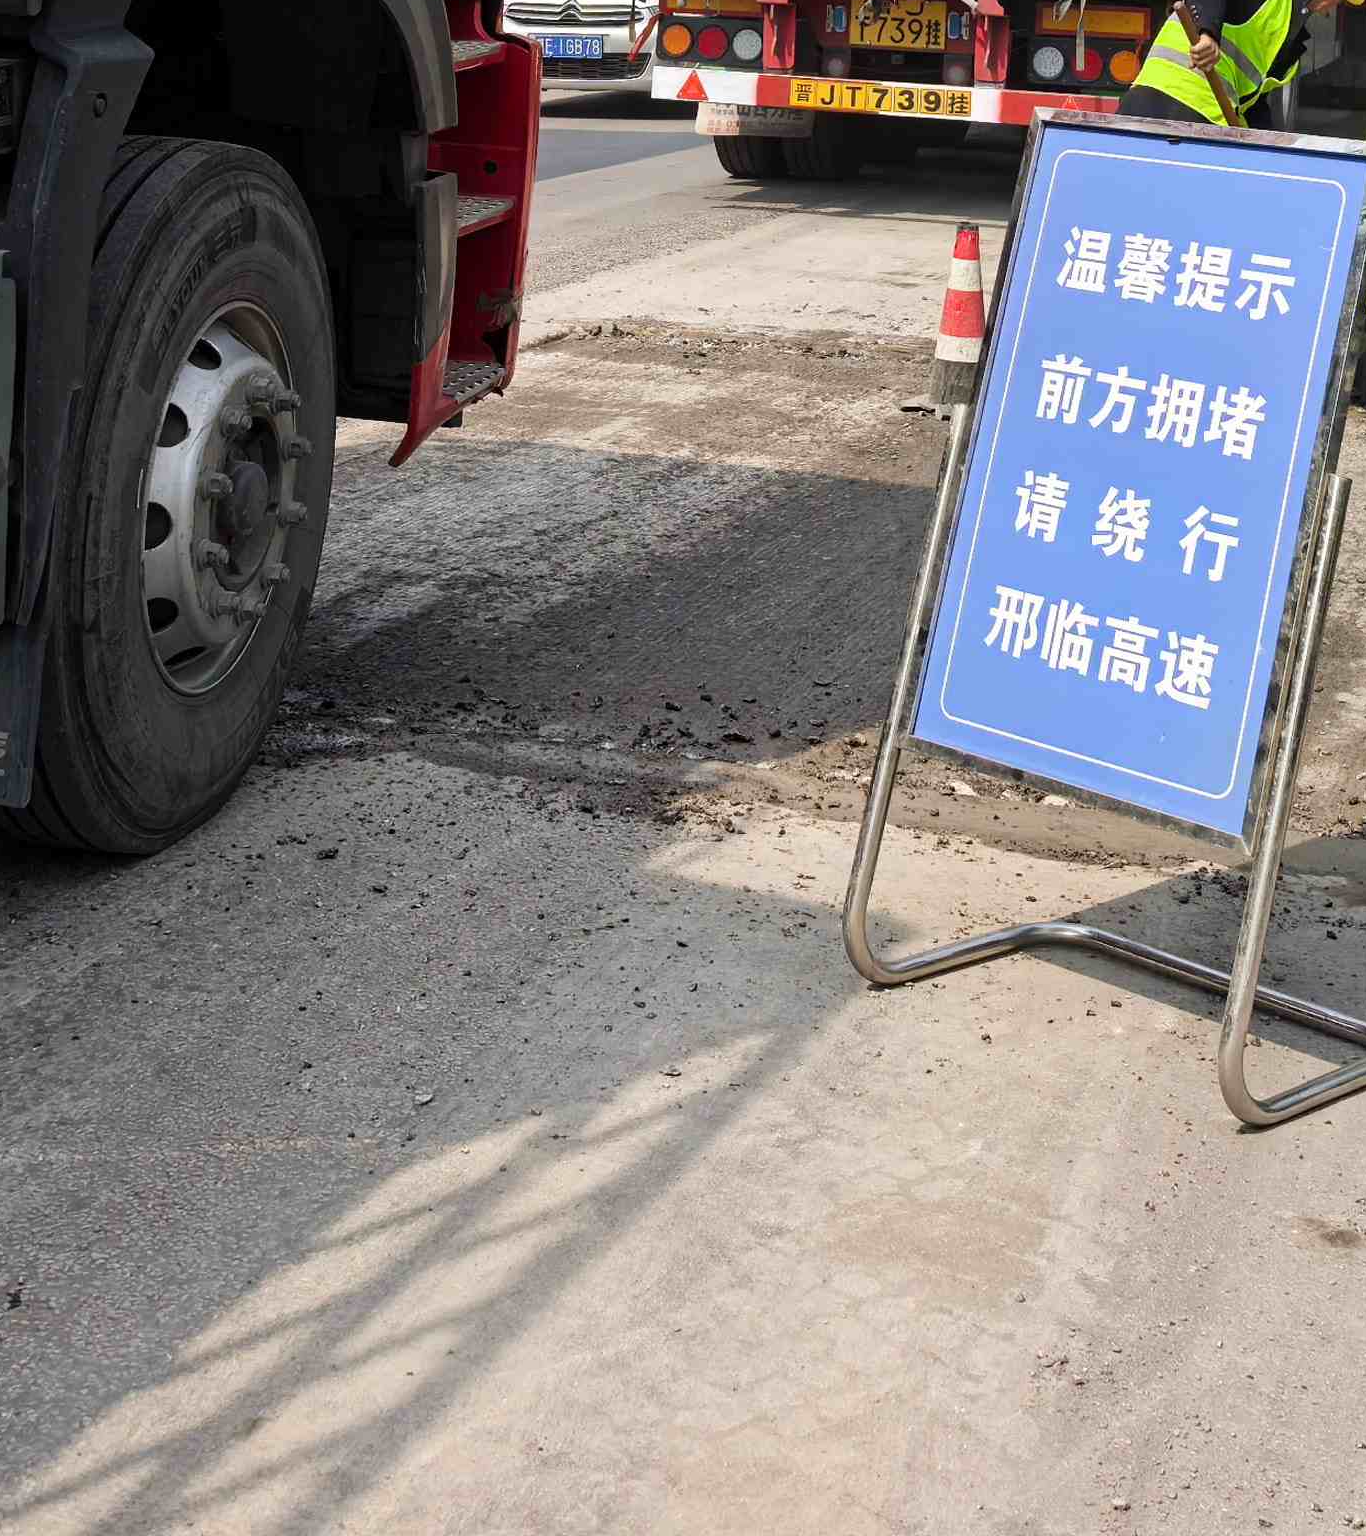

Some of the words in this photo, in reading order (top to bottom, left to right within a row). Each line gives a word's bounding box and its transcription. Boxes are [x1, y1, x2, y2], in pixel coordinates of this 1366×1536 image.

[795, 83, 969, 115] 晋JT739挂
[1056, 225, 1297, 321] 温馨提示
[1035, 354, 1267, 461] 前方拥堵
[1014, 470, 1240, 583] 请绕行
[983, 584, 1220, 709] 邢临高速
